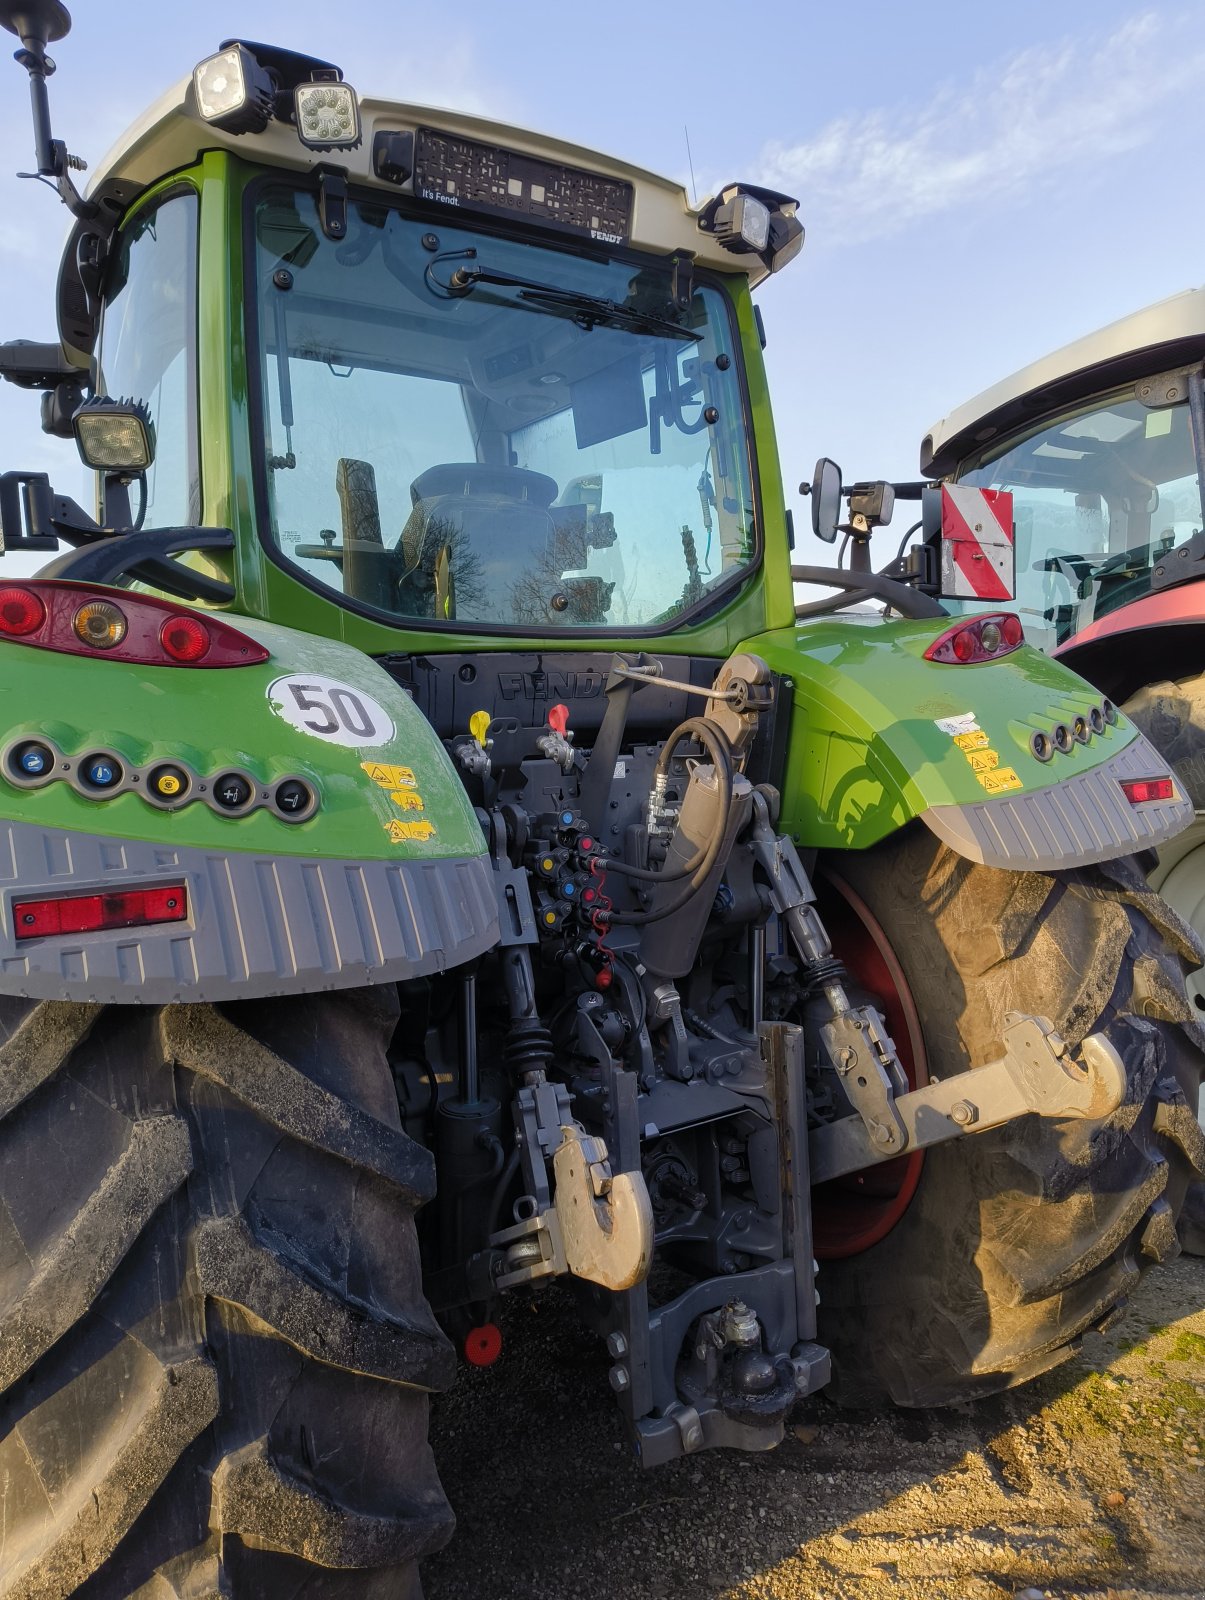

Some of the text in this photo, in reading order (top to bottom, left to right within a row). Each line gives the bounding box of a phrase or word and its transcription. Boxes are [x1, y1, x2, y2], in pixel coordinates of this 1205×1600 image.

[422, 188, 460, 207] It's Fendt.
[590, 229, 623, 244] FENDT
[287, 683, 377, 738] 50
